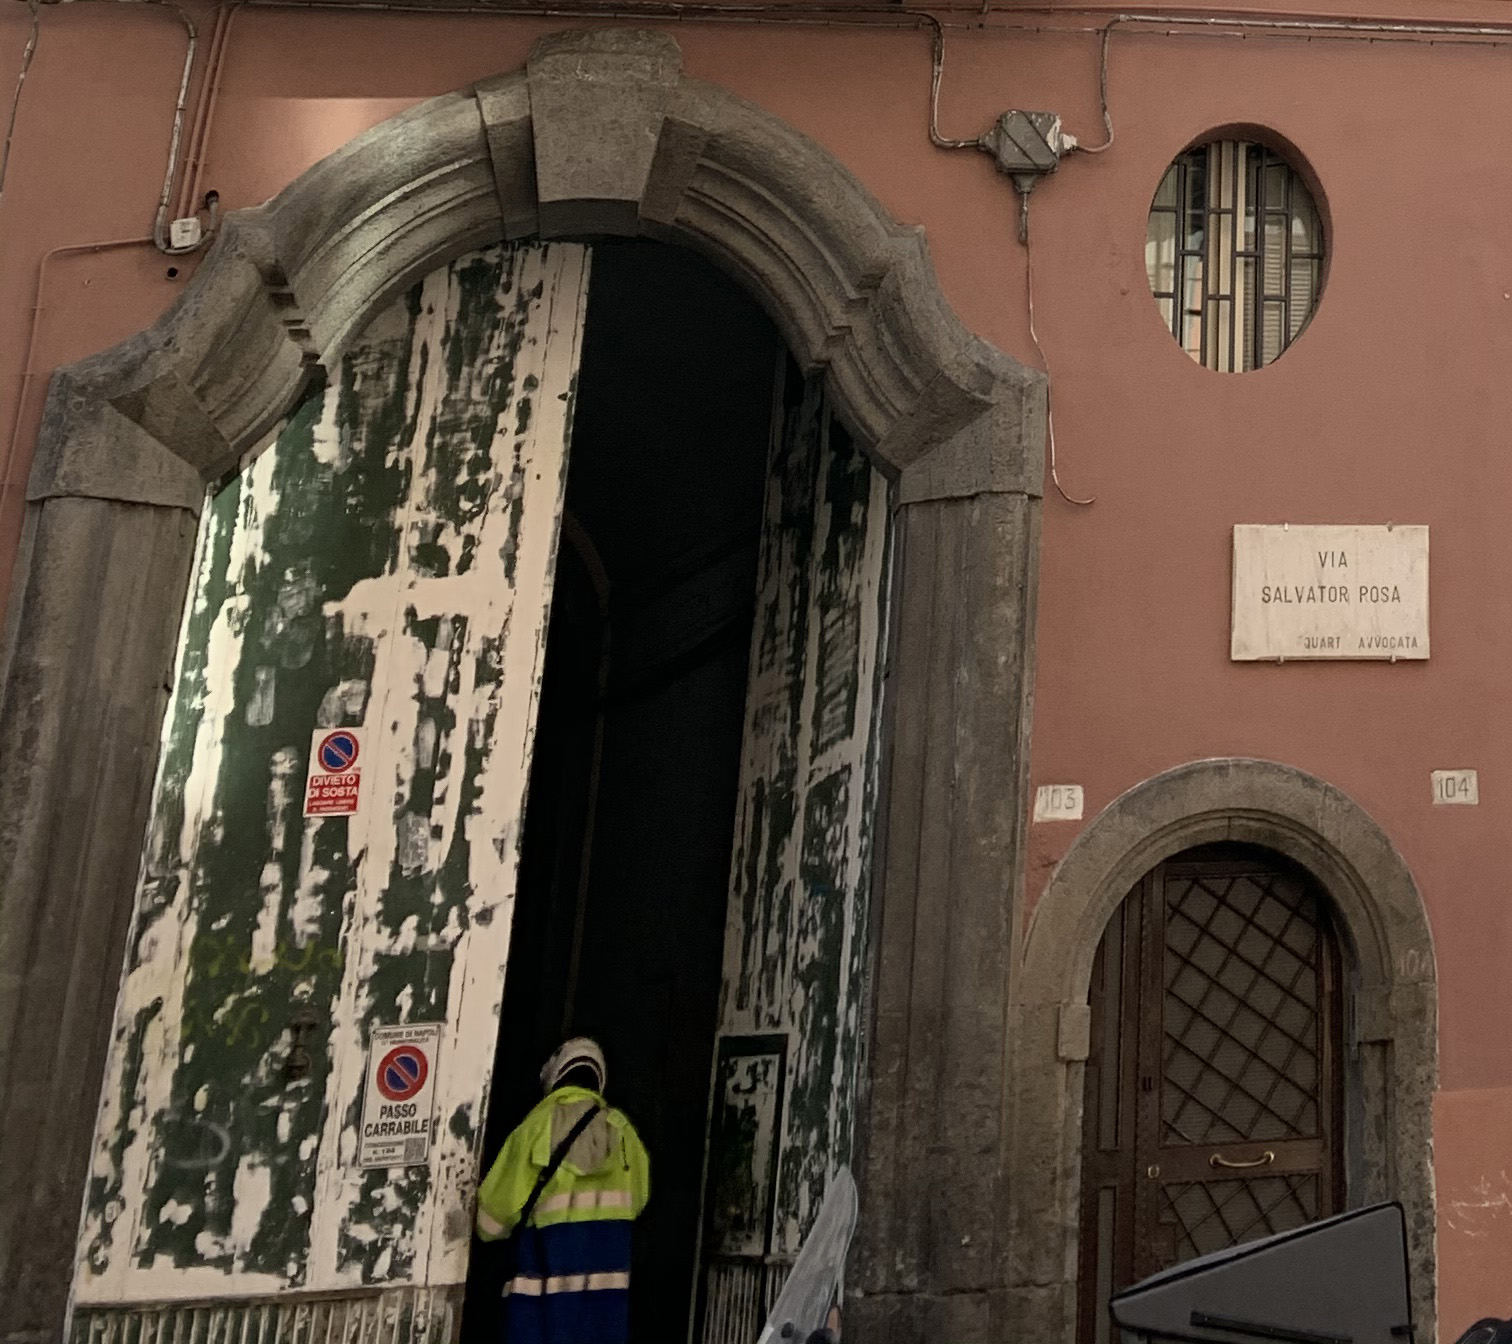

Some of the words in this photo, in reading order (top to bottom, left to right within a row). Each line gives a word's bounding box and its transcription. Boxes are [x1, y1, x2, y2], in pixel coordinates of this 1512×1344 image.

[1318, 551, 1348, 567] VIA
[1261, 585, 1349, 604] SALVATOR
[1358, 636, 1419, 649] AVVOCATA
[312, 774, 356, 786] DIVIETO
[1439, 776, 1470, 799] 104
[309, 787, 320, 798] DI
[322, 786, 358, 798] SOSTA
[379, 1104, 417, 1119] PASSO
[364, 1118, 429, 1137] CARRABILE
